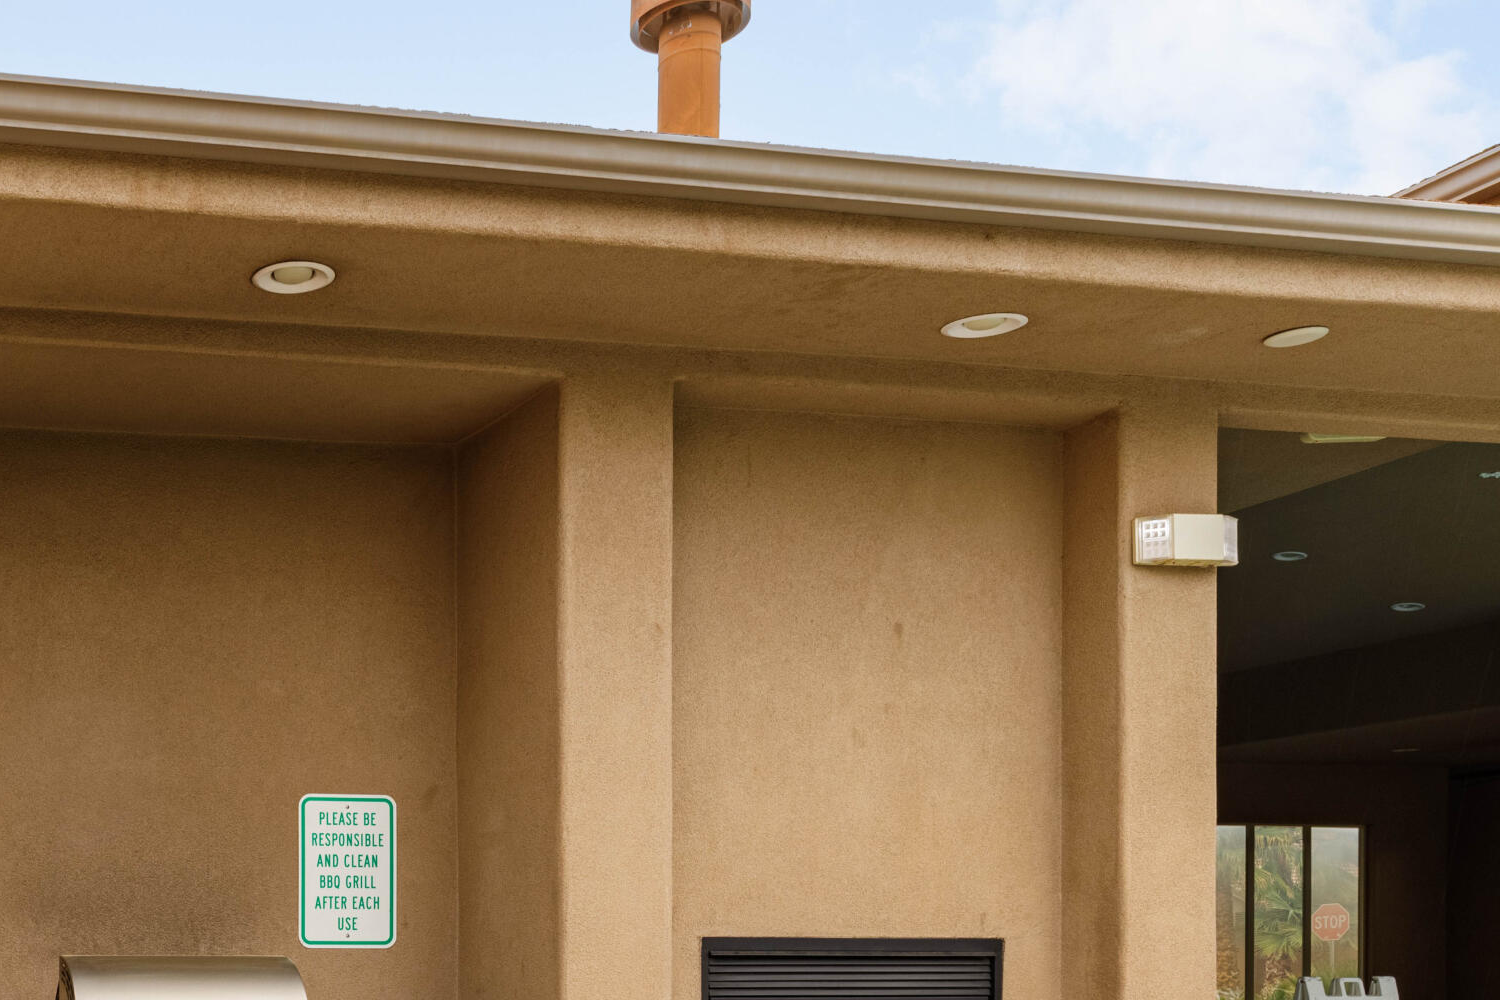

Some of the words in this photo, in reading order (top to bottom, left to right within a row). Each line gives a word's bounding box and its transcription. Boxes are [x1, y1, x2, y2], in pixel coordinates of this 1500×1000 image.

[319, 812, 358, 826] PLEASE
[363, 812, 377, 826] BE
[311, 832, 384, 847] RESPONSIBLE
[316, 854, 339, 868] AND
[344, 854, 378, 868] CLEAN
[319, 875, 341, 889] BBQ
[345, 875, 376, 889] GRILL
[315, 896, 347, 910] AFTER
[352, 896, 380, 910] EACH
[337, 917, 358, 931] USE
[1314, 914, 1347, 930] STOP
